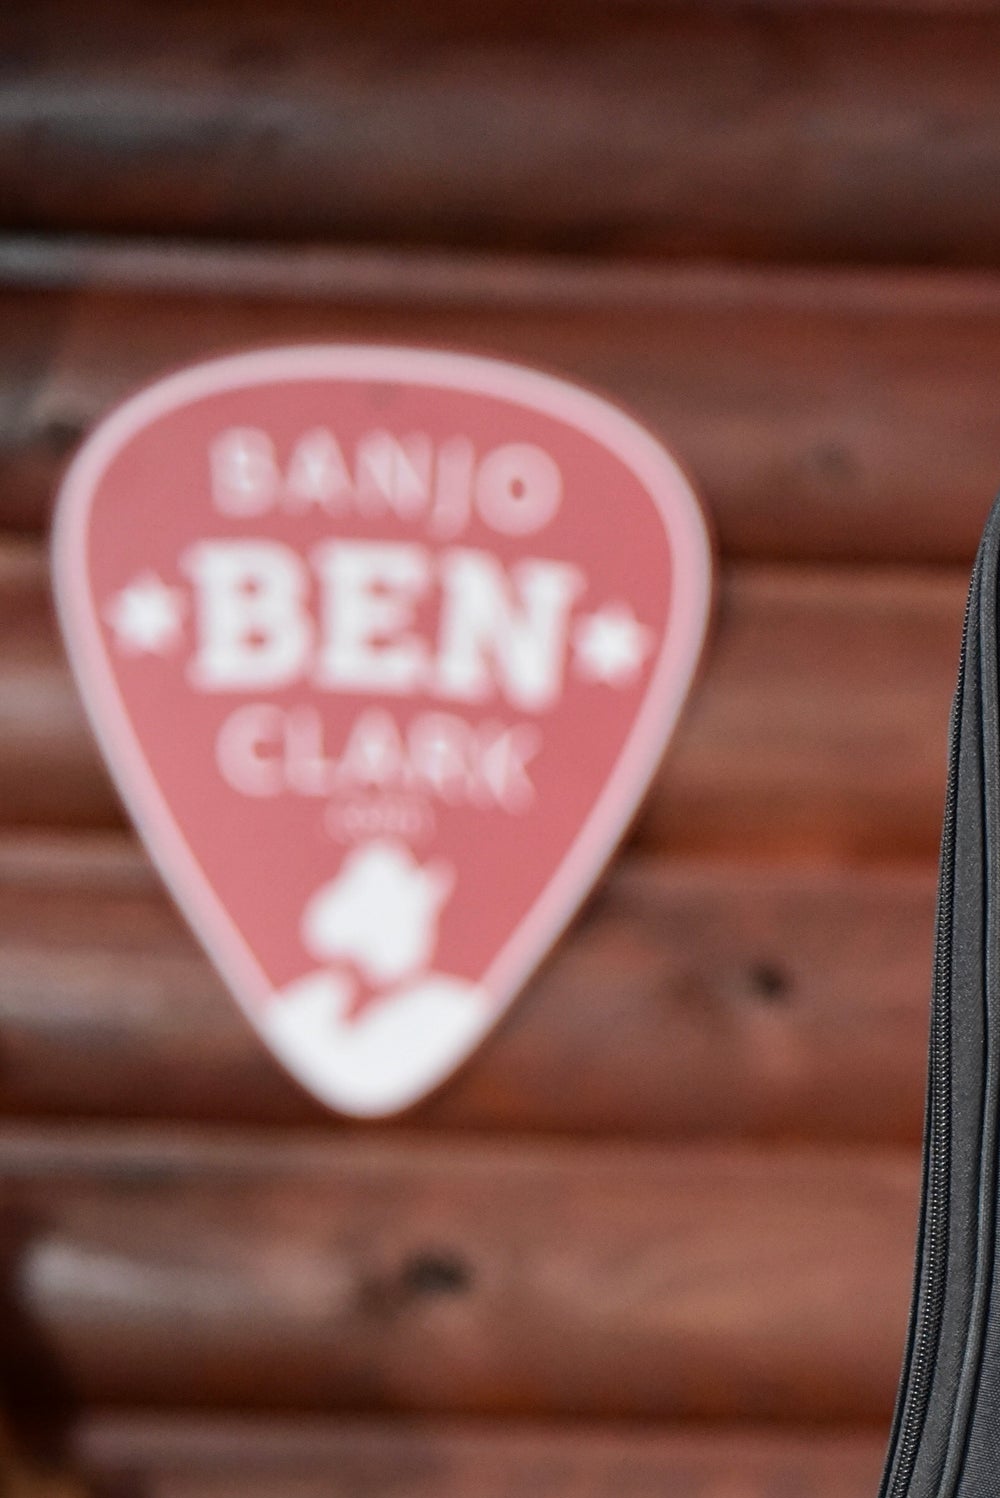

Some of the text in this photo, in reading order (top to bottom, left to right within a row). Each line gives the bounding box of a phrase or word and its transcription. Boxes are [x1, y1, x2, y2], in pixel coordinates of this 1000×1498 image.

[210, 427, 562, 536] BANJO
[184, 538, 585, 708] BEN
[216, 705, 540, 812] CLARK
